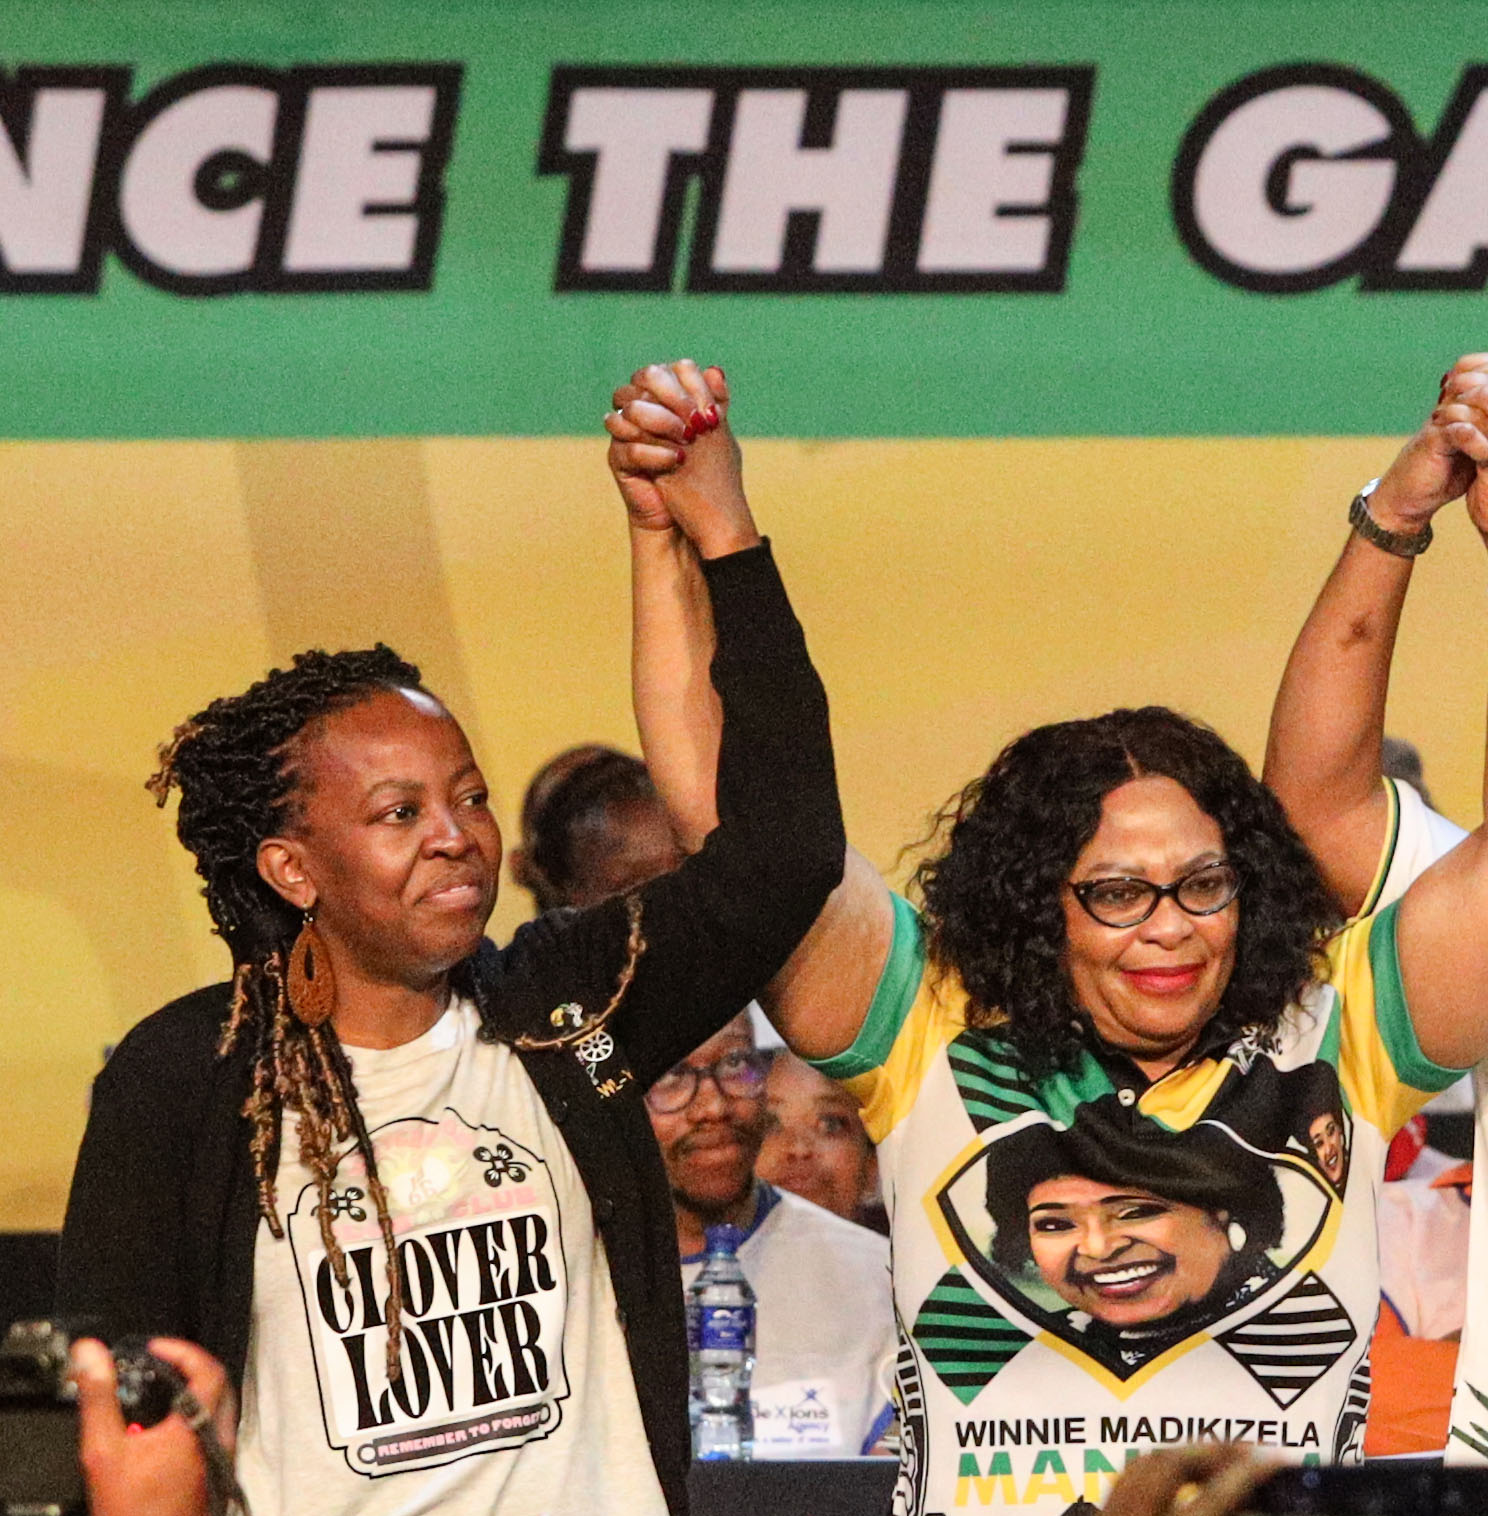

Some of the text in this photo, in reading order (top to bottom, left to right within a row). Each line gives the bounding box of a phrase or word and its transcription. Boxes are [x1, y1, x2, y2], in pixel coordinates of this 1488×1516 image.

[547, 76, 1085, 283] THE
[316, 1213, 557, 1335] CLOVER
[340, 1299, 550, 1431] LOVER
[377, 1410, 542, 1458] REMEMBER TO FORGET
[955, 1416, 1321, 1449] WINNIE MADIKIZELA
